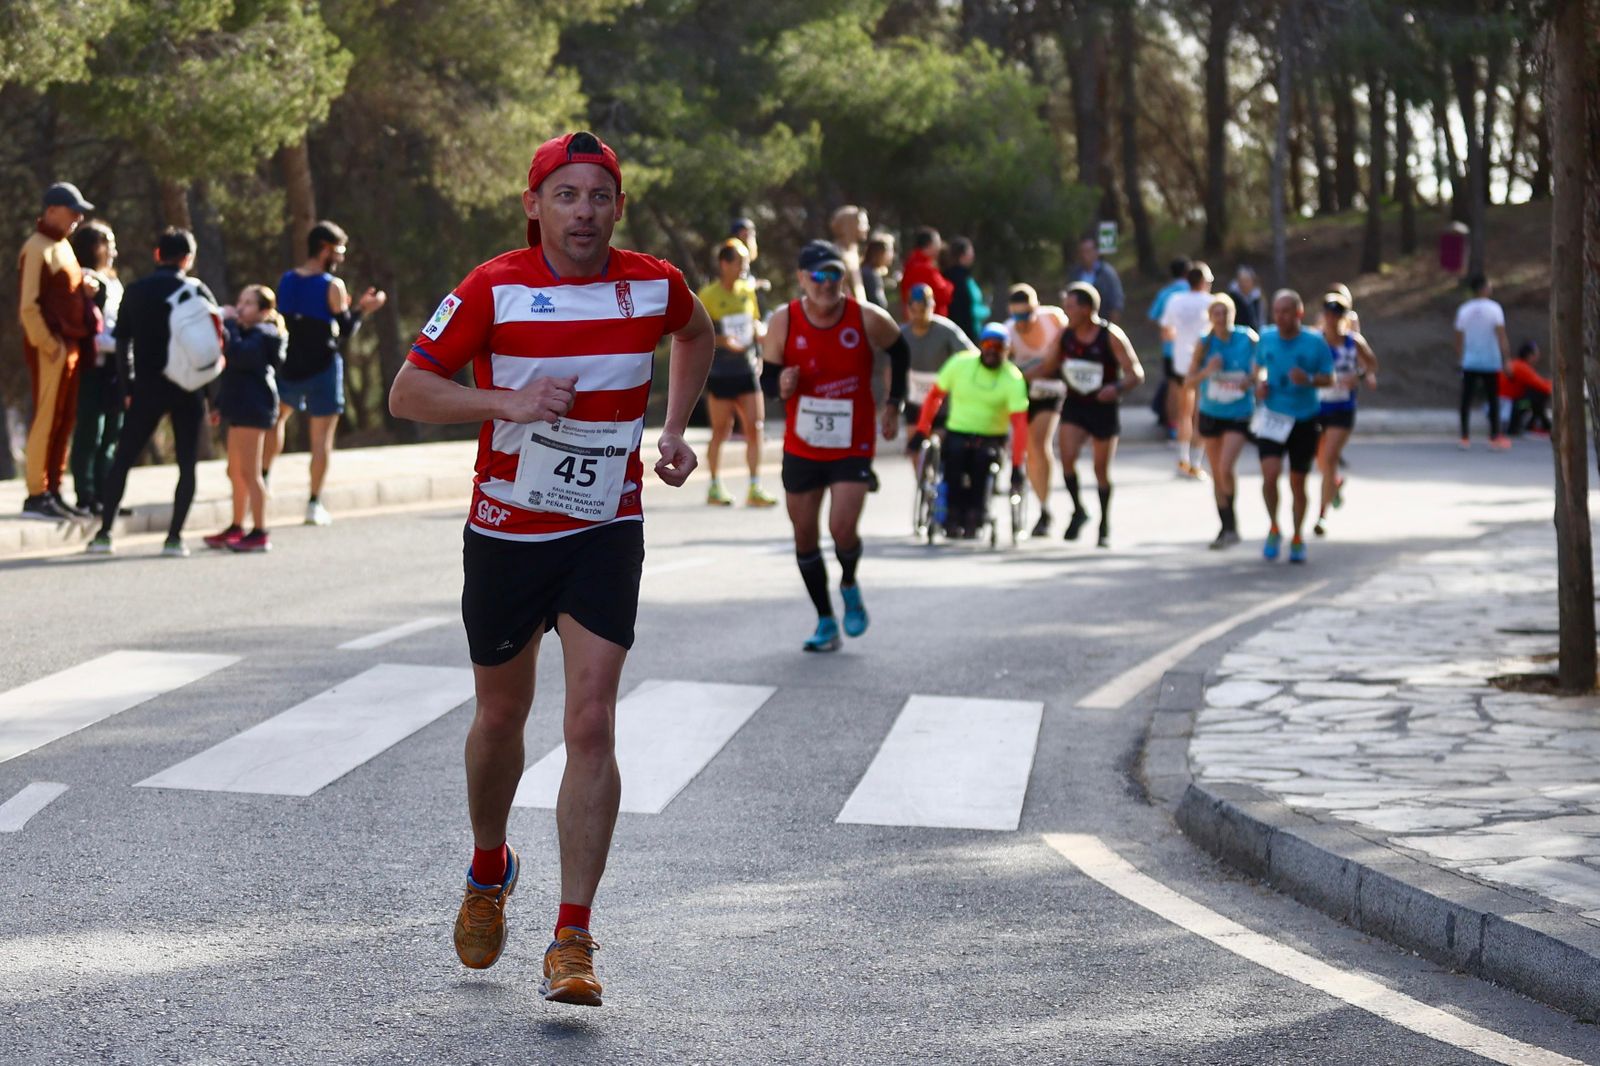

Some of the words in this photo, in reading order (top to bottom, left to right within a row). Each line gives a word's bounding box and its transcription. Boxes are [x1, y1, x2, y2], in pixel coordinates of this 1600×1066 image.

[425, 323, 438, 335] LFP
[815, 415, 835, 432] 53
[553, 455, 598, 488] 45
[545, 499, 564, 508] PEÑA
[565, 503, 574, 511] EL
[575, 505, 602, 515] BASTÓN
[558, 494, 572, 502] MINI
[573, 497, 605, 507] MARATÓN
[478, 499, 511, 527] GCF
